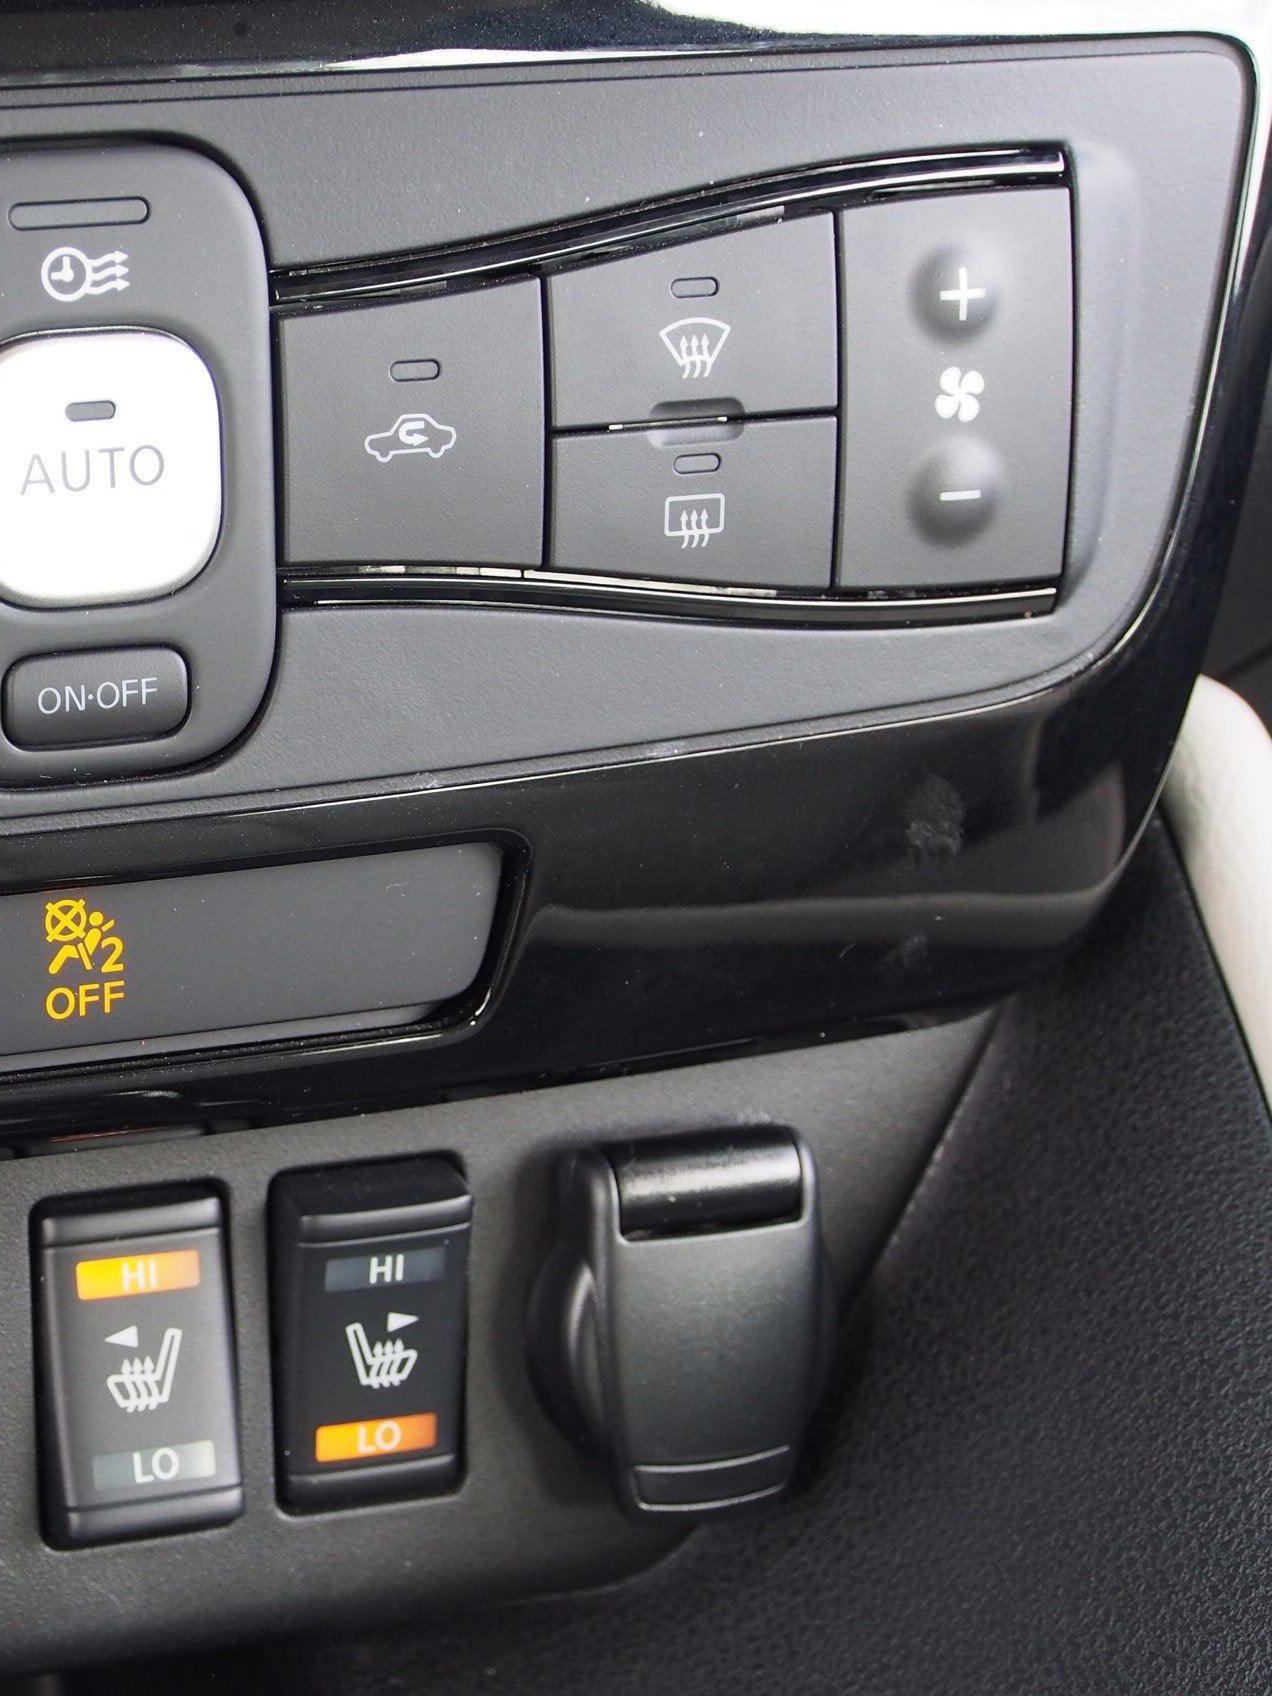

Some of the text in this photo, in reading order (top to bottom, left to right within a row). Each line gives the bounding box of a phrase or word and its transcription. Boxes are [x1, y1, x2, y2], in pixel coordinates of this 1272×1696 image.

[20, 444, 165, 496] AUTO
[46, 980, 126, 1020] OFF
[122, 1255, 159, 1291] HI
[368, 1253, 405, 1285] HI
[358, 1418, 402, 1454] LO
[133, 1447, 180, 1484] LO
